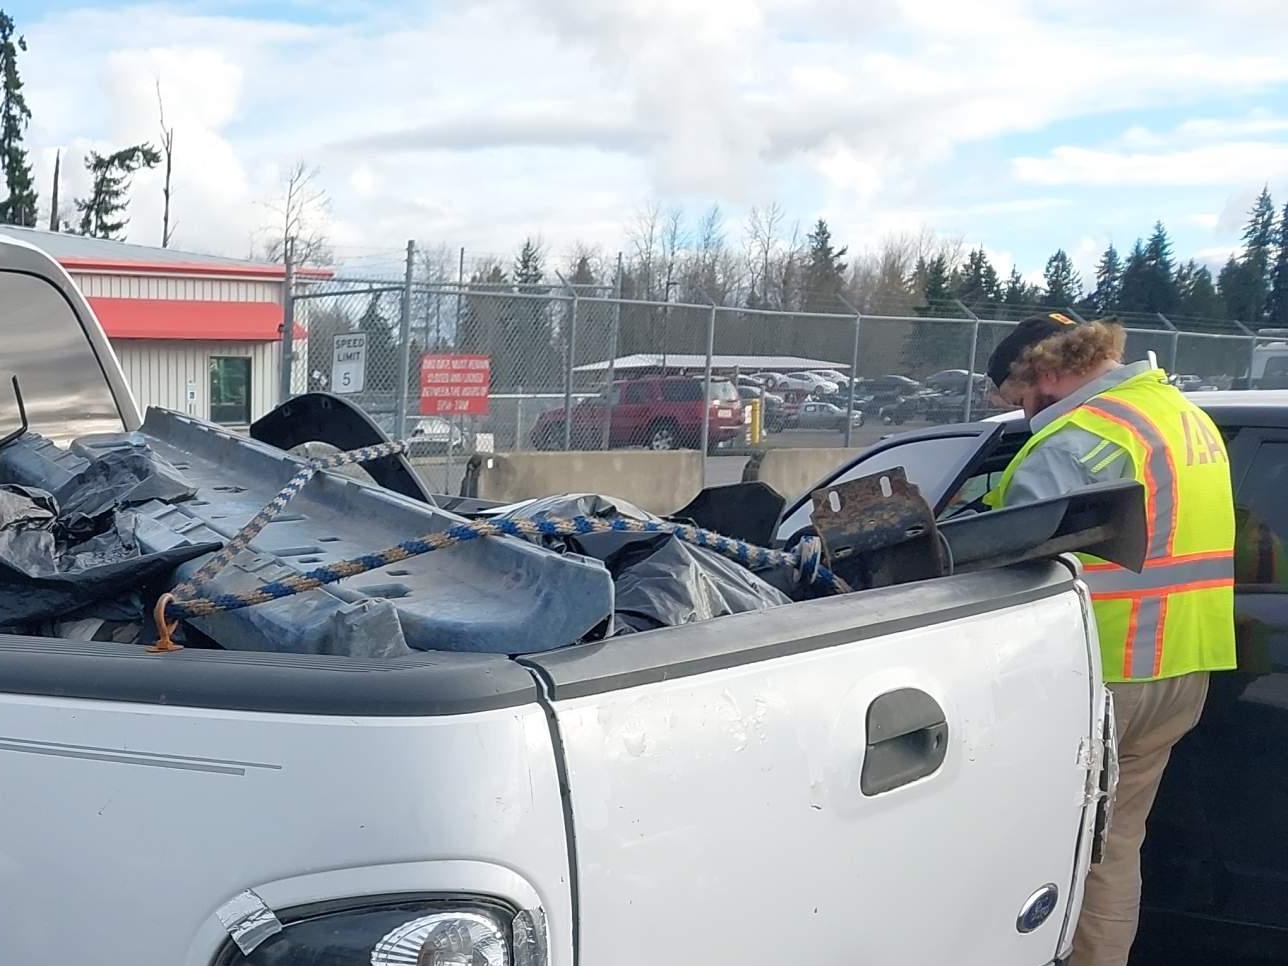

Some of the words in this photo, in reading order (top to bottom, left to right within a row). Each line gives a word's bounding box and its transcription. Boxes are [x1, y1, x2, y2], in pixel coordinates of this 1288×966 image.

[336, 337, 364, 349] SPEED
[337, 351, 360, 362] LIMIT
[342, 373, 351, 386] 5
[1181, 410, 1227, 467] IAA
